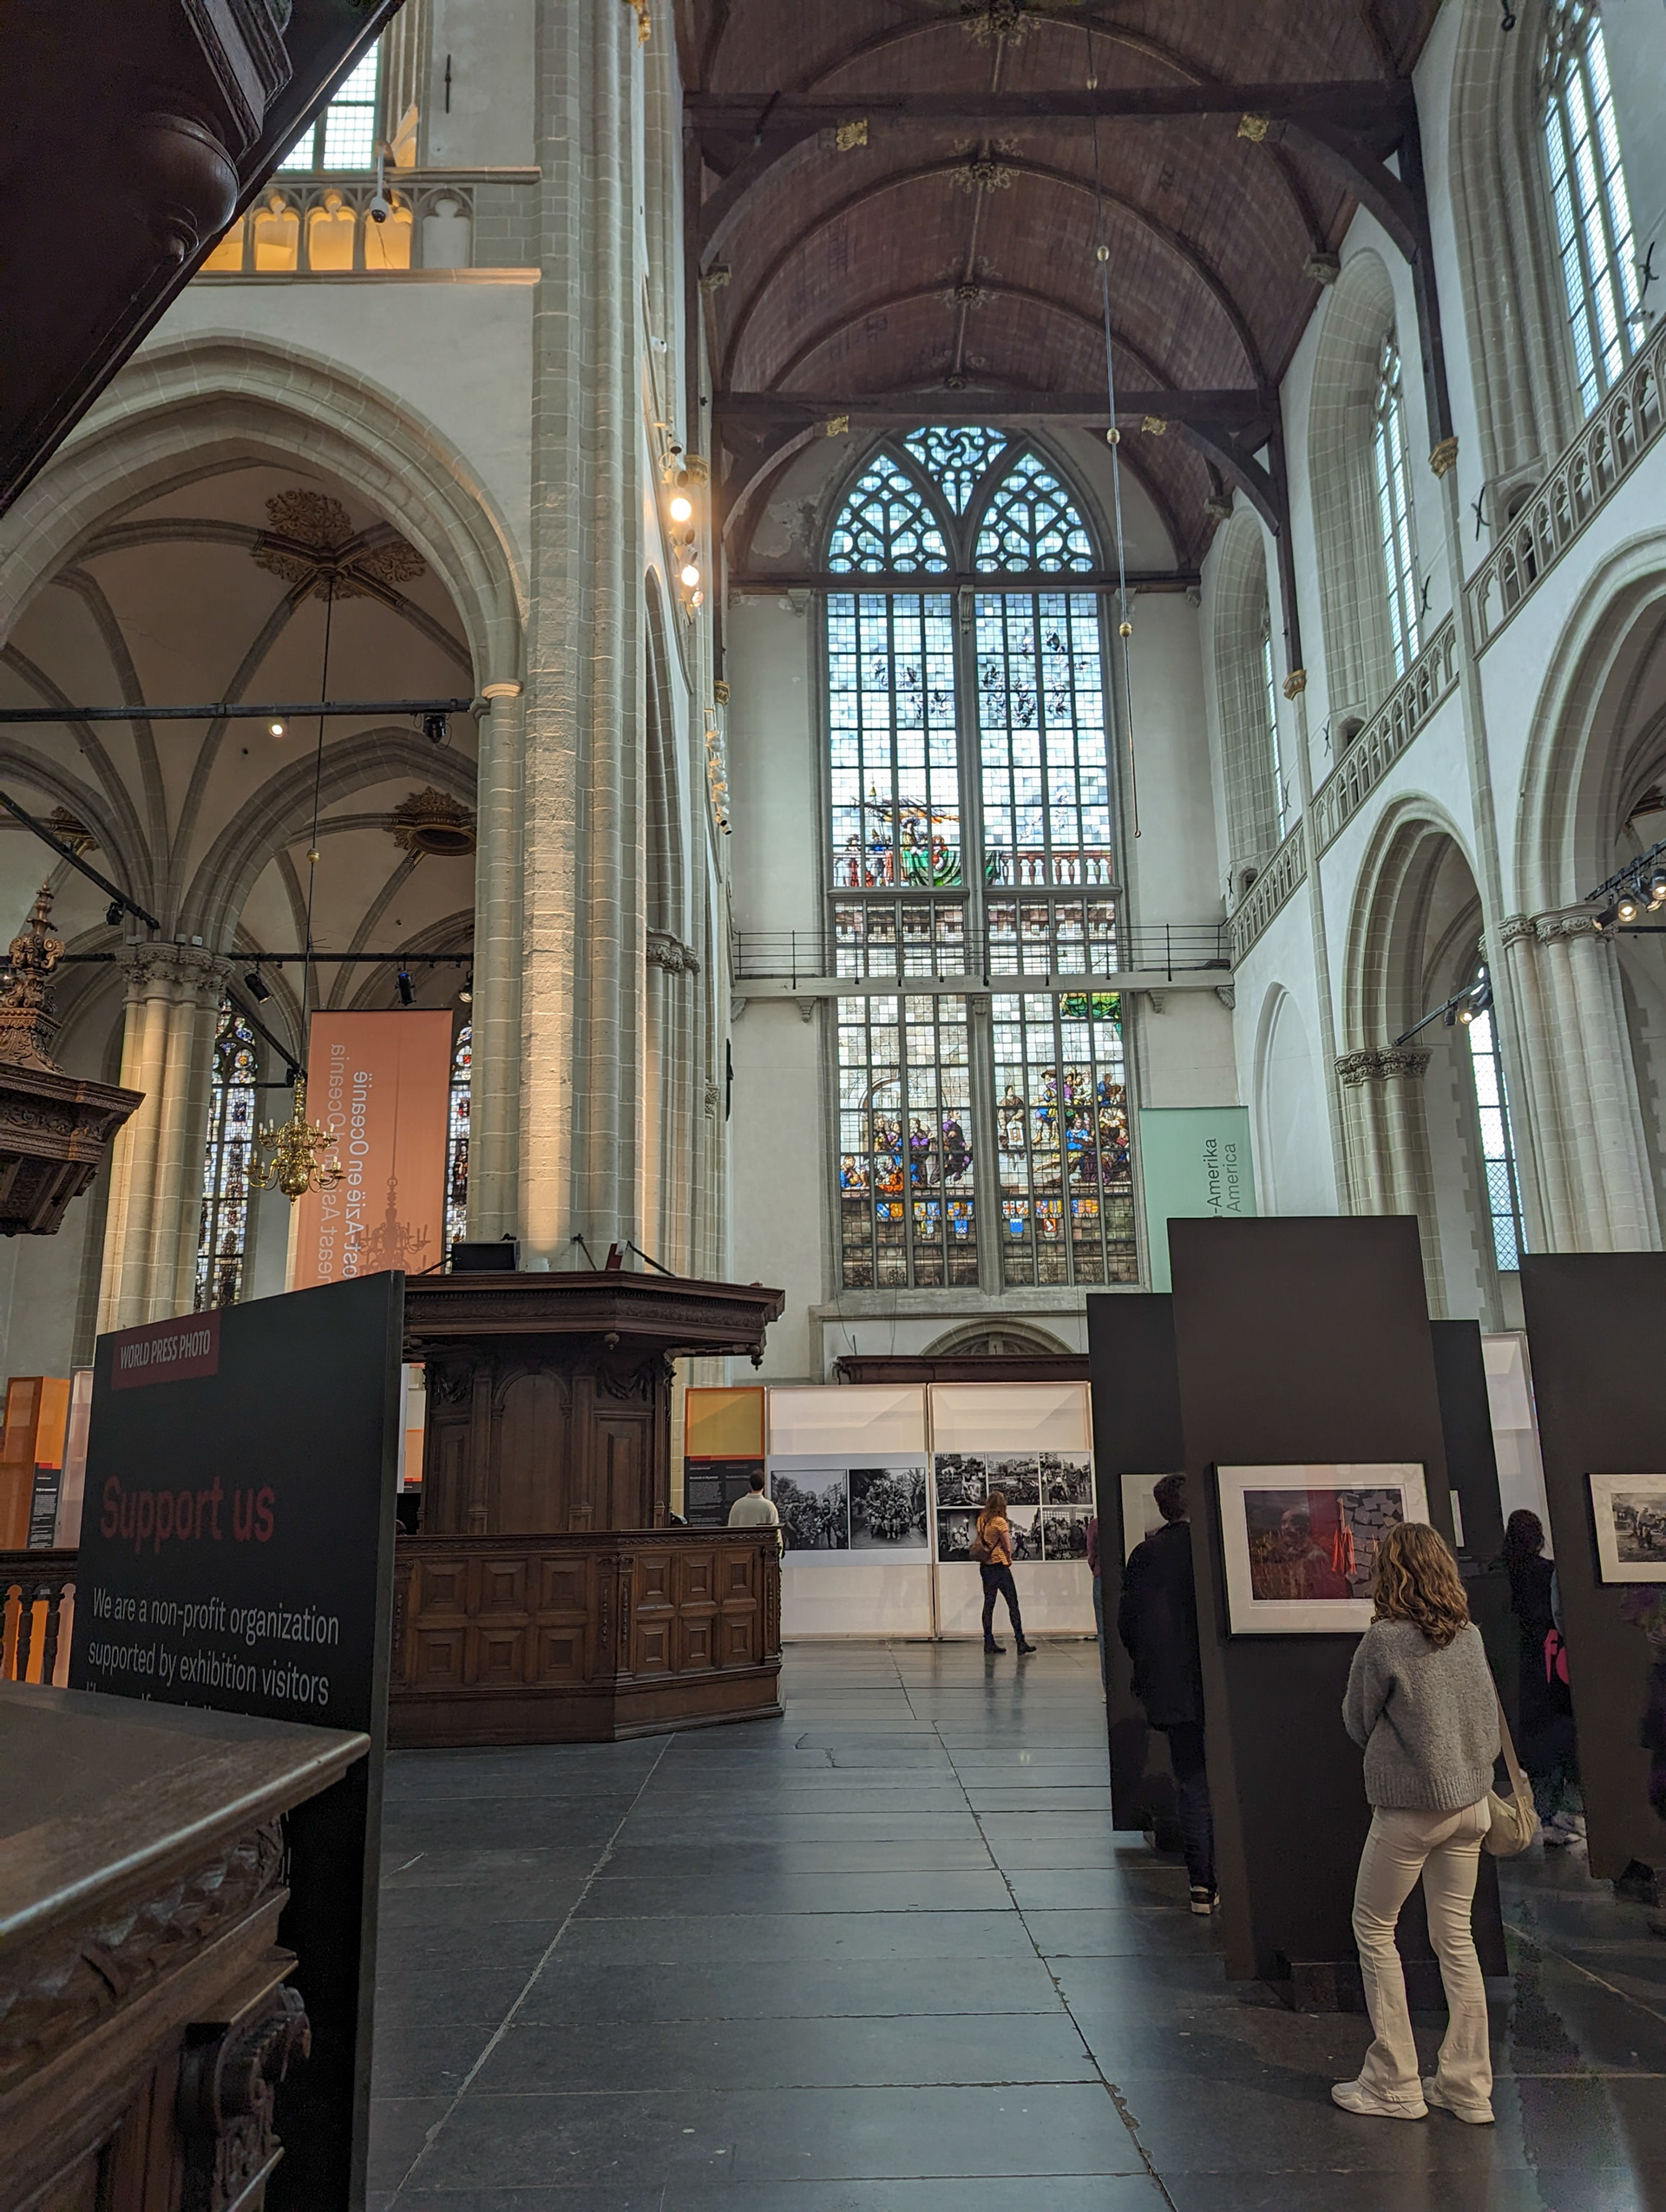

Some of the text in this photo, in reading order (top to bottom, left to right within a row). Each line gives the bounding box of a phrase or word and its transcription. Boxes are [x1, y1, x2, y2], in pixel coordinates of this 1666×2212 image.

[1203, 1138, 1223, 1217] -Amerika
[1223, 1143, 1241, 1212] America
[121, 1329, 211, 1369] WORLD PRESS PHOTO
[100, 1475, 224, 1555] Support
[233, 1485, 275, 1542] us
[93, 1587, 339, 1646] We are a non-profit organization
[88, 1641, 329, 1705] supported by exhibition visitors
